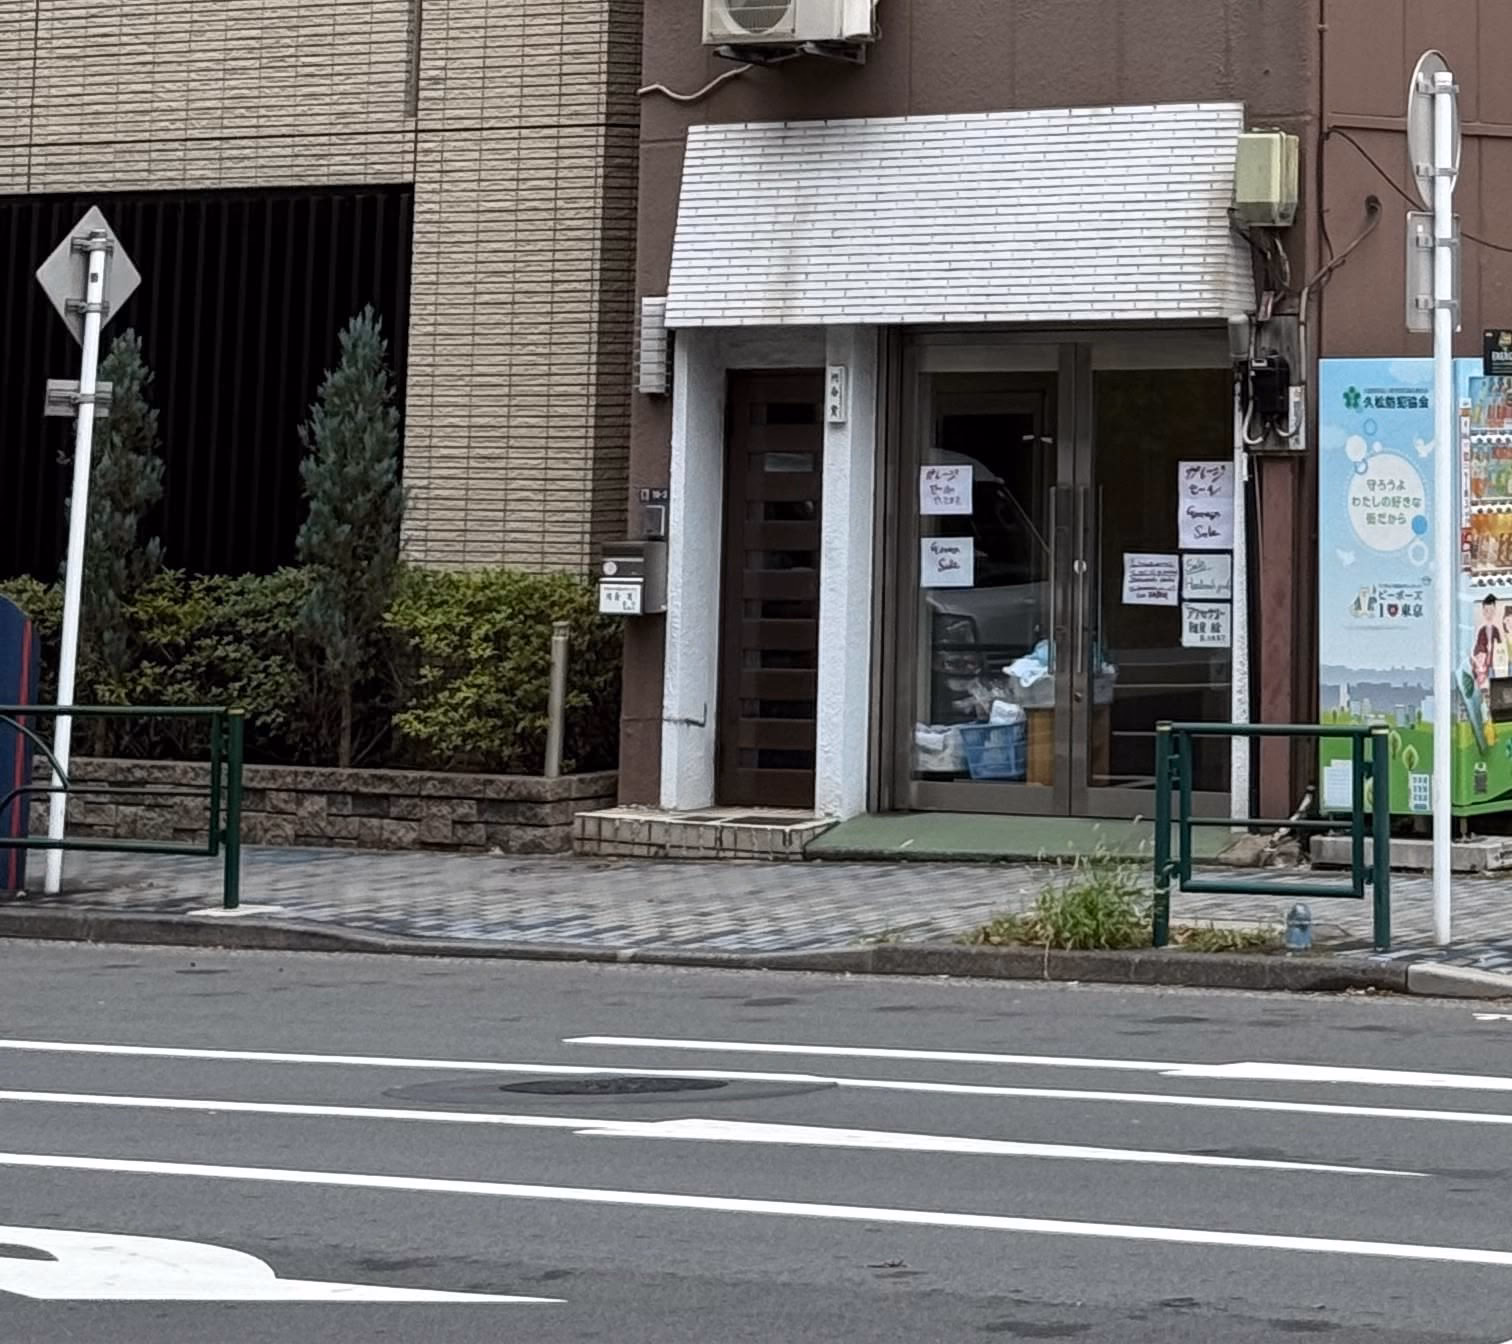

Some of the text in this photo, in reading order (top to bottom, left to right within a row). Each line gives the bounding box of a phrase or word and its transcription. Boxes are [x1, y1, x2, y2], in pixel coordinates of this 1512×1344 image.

[1363, 395, 1429, 409] 久松防犯協会
[1366, 479, 1406, 491] 守ろうよ
[1352, 496, 1422, 508] わたしの好きな
[1366, 512, 1407, 525] 街だから
[1401, 603, 1423, 618] 東京
